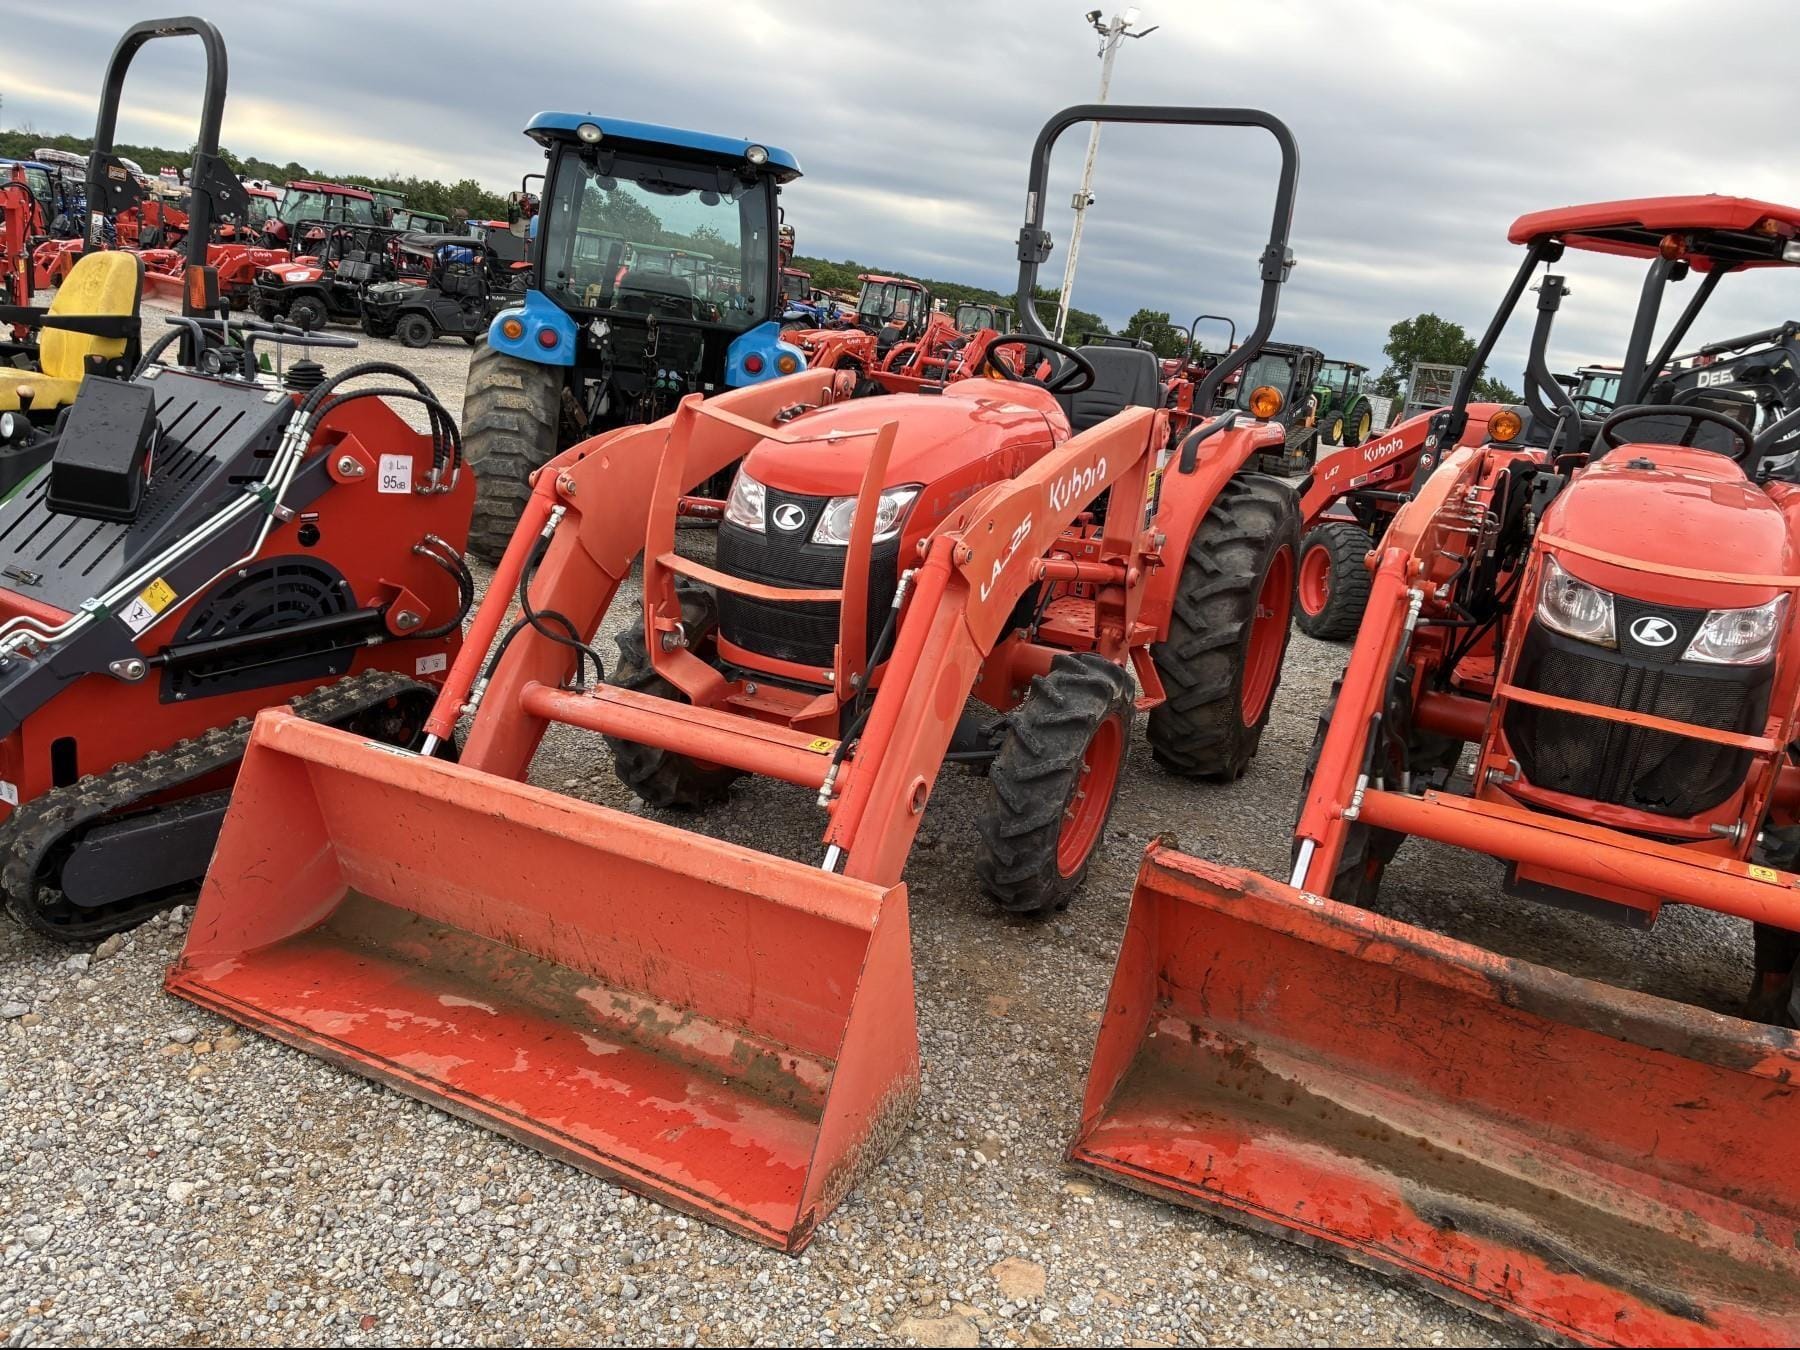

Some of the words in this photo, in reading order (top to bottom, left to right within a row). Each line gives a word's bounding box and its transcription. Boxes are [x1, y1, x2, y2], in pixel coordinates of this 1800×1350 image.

[1364, 438, 1403, 462] Kubota
[1049, 457, 1107, 512] Kubota
[980, 512, 1033, 602] LA25
